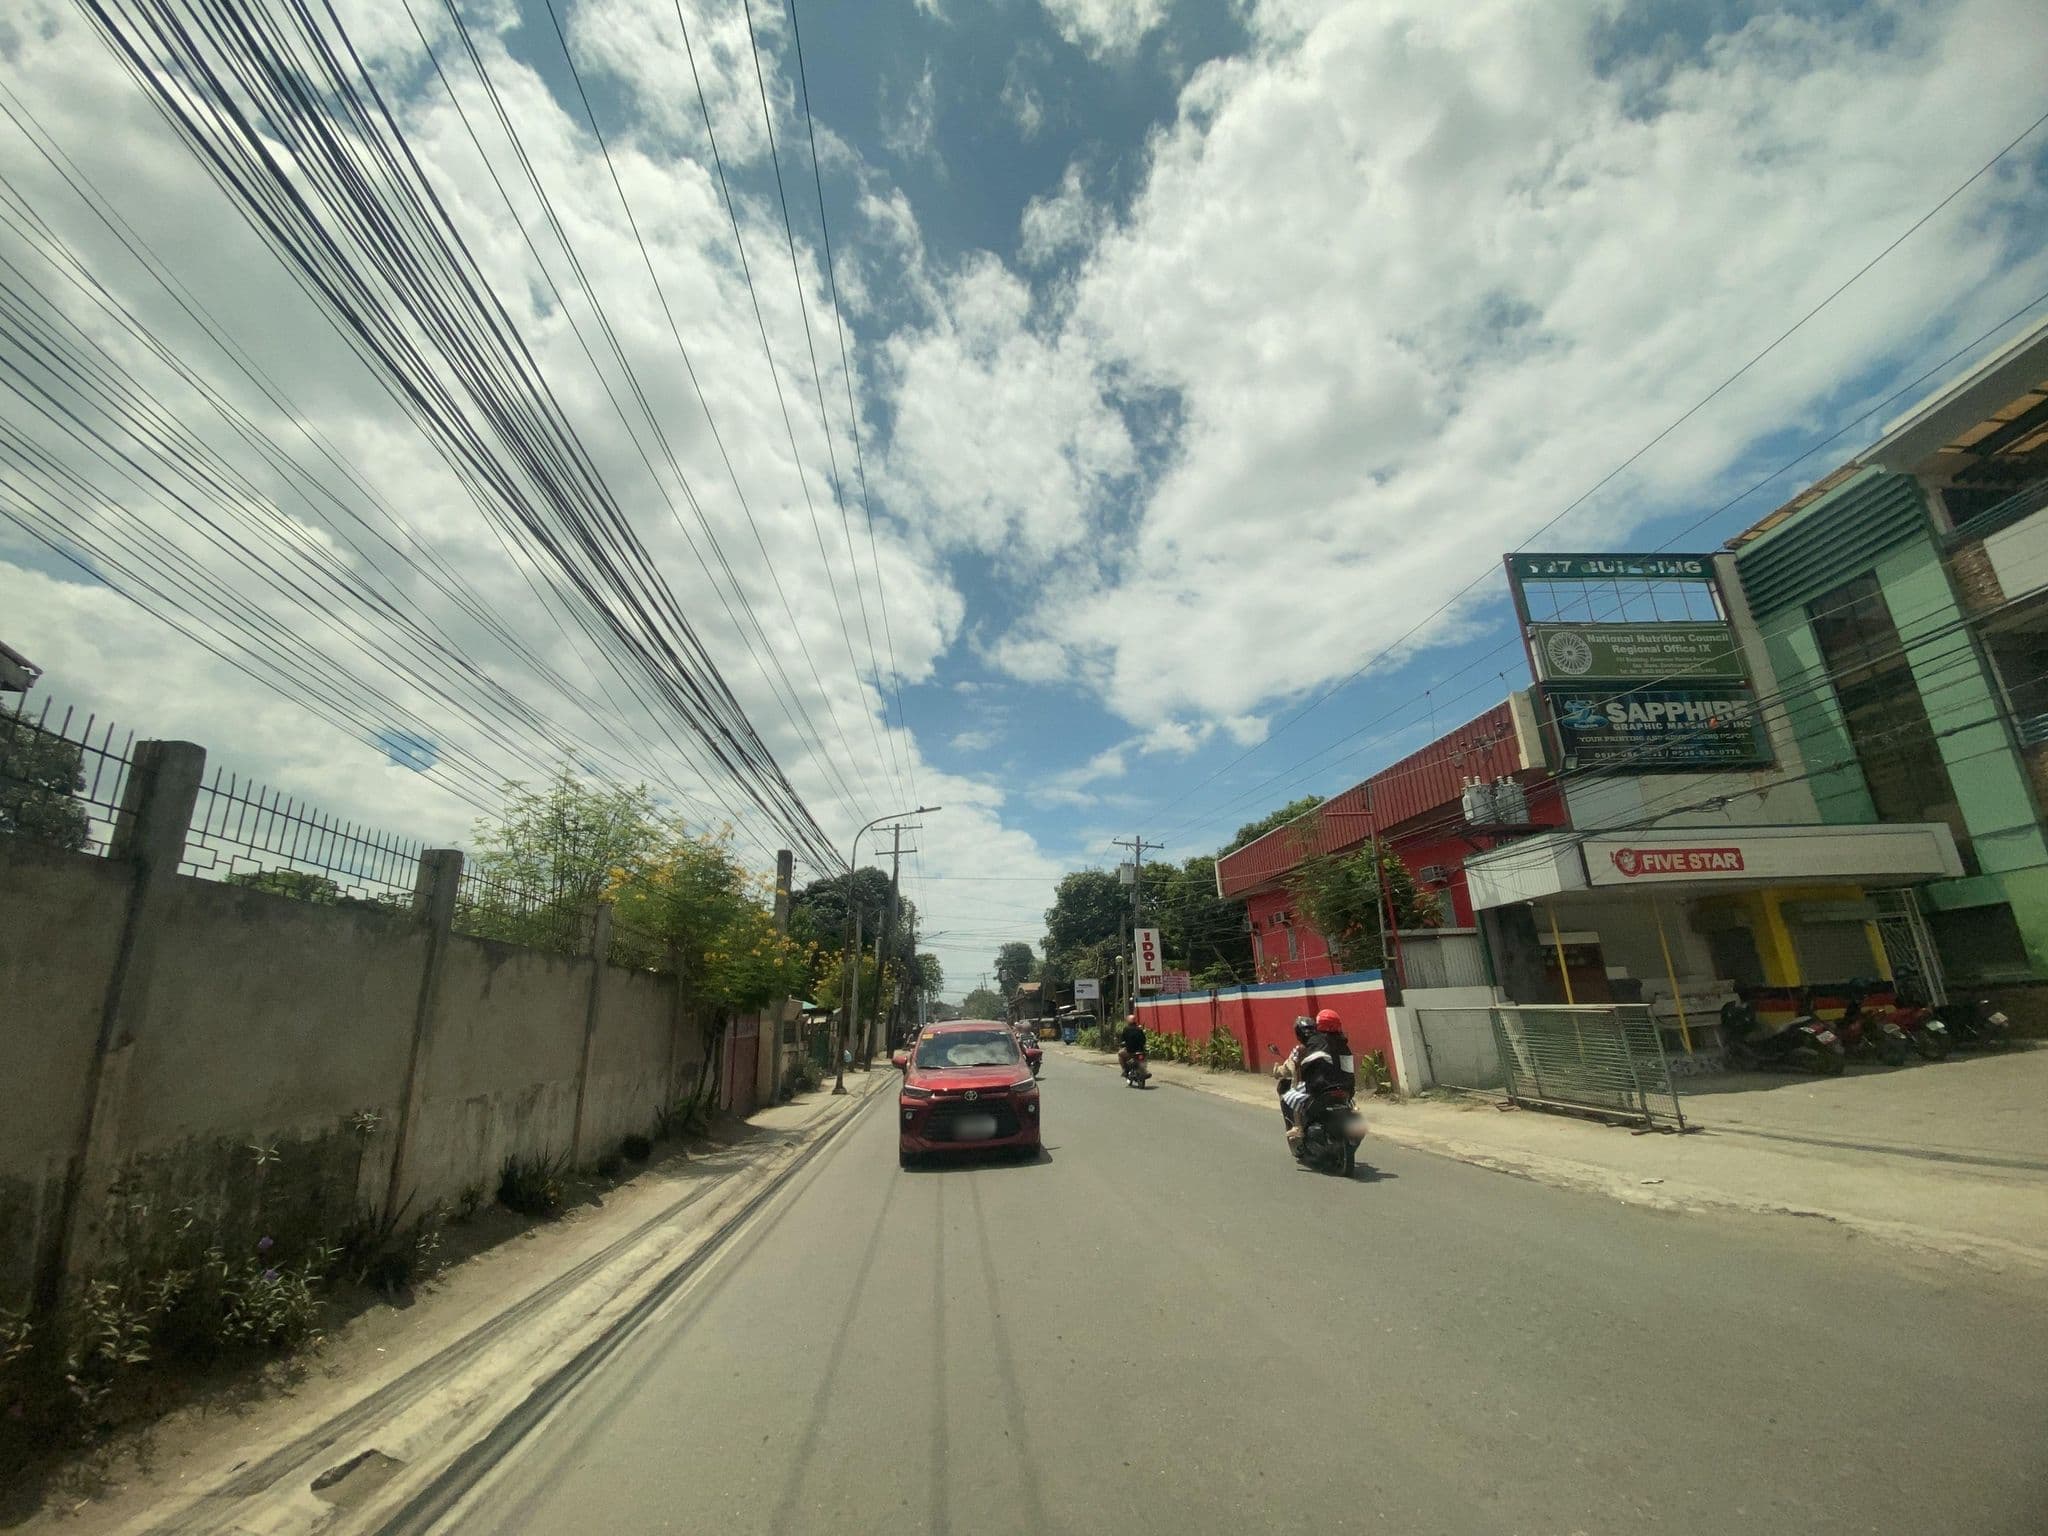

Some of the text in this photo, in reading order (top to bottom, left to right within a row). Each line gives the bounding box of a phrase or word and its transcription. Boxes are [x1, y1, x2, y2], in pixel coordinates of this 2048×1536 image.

[1587, 633, 1729, 643] National Nutrition Council
[1612, 644, 1711, 655] Regional Office IX
[1606, 701, 1752, 723] SAPPHIRE
[1613, 722, 1663, 731] GRAPHIC
[1666, 720, 1729, 730] MATERIS
[1642, 852, 1739, 871] FIVE STAR
[1142, 932, 1155, 972] IDOL
[1140, 975, 1162, 985] MOTEL
